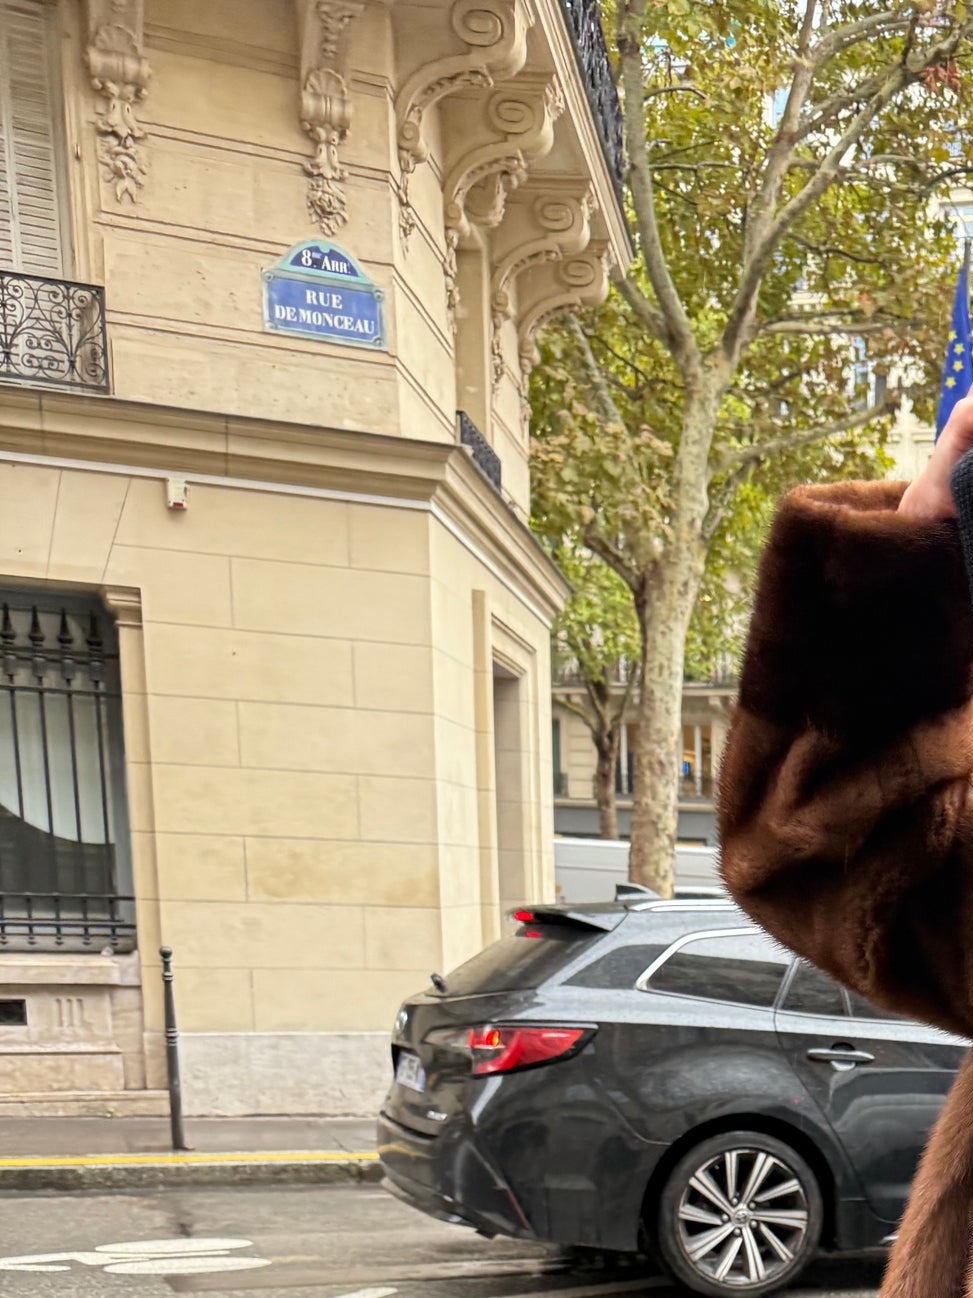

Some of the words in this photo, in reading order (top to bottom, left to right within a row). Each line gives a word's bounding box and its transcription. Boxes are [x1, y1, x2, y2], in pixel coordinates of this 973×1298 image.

[305, 289, 343, 309] RUE
[275, 305, 297, 321] DE
[299, 308, 374, 333] MONCEAU
